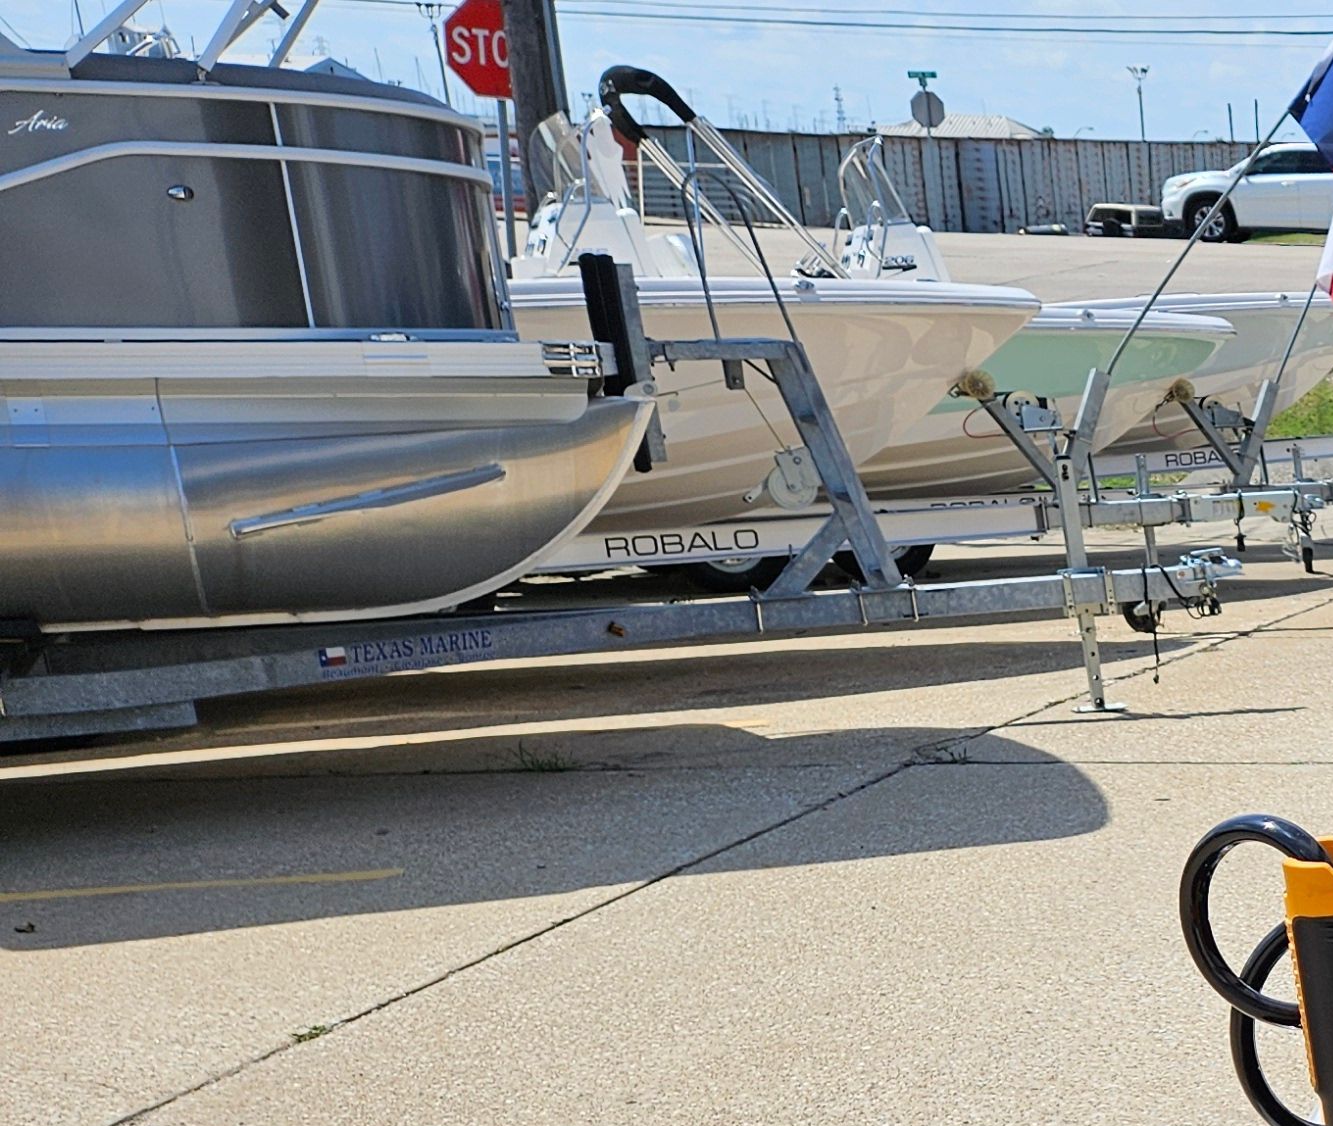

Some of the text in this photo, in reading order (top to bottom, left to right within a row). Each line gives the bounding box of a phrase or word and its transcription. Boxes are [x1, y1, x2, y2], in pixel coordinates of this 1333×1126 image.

[451, 26, 509, 68] STO
[8, 110, 68, 134] Aria
[605, 529, 759, 558] ROBALO
[353, 630, 492, 663] TEXAS MARINE
